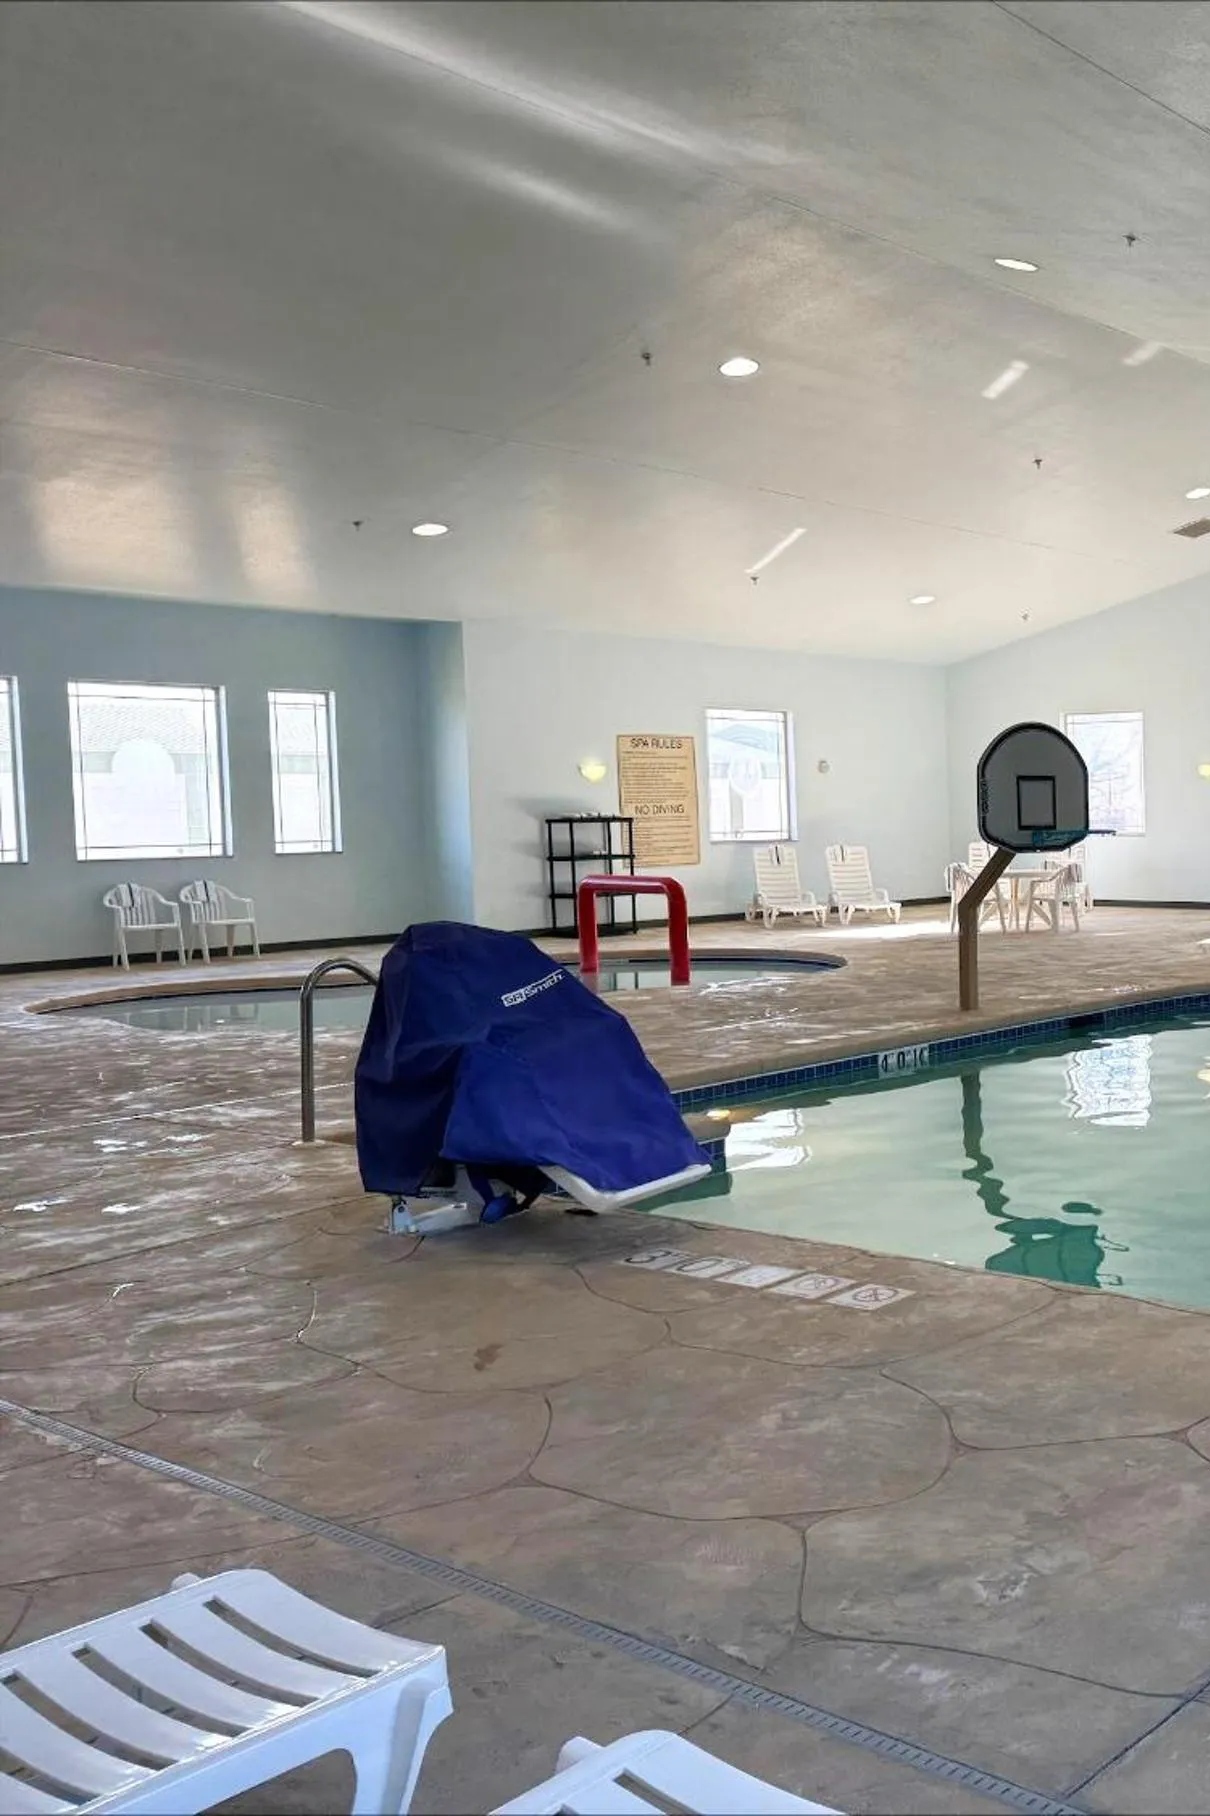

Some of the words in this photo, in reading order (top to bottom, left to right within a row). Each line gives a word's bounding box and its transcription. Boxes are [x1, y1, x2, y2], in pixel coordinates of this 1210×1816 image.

[630, 738, 649, 749] SPA
[651, 738, 682, 749] RULES
[635, 804, 650, 815] NO
[652, 804, 685, 815] DIVING
